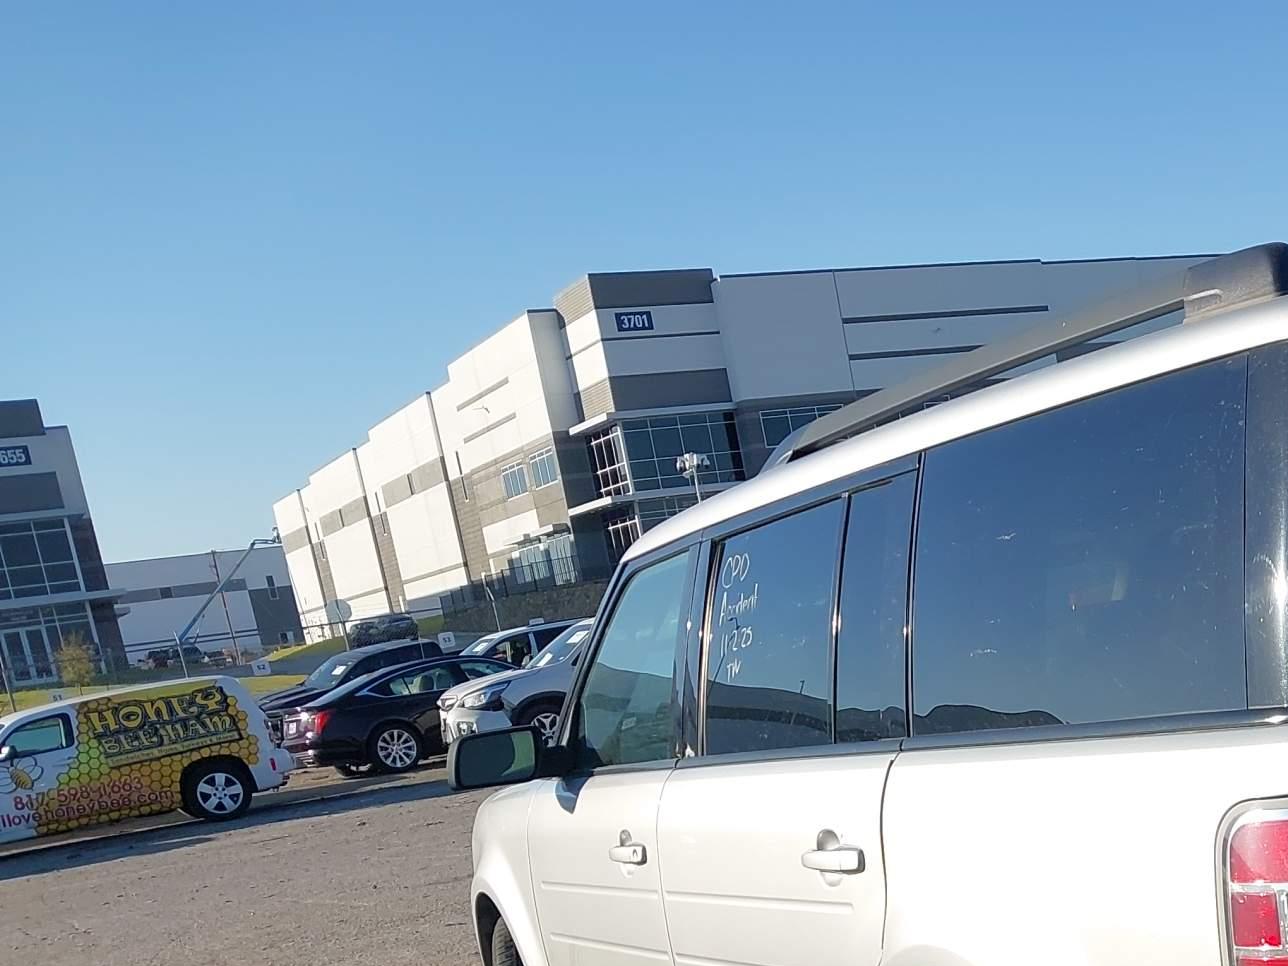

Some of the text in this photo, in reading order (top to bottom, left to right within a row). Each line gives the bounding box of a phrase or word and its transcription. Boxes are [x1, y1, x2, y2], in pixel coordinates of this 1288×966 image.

[620, 314, 649, 329] 3701
[87, 686, 226, 734] HONEY
[102, 724, 161, 754] BEE
[161, 714, 236, 745] HAM
